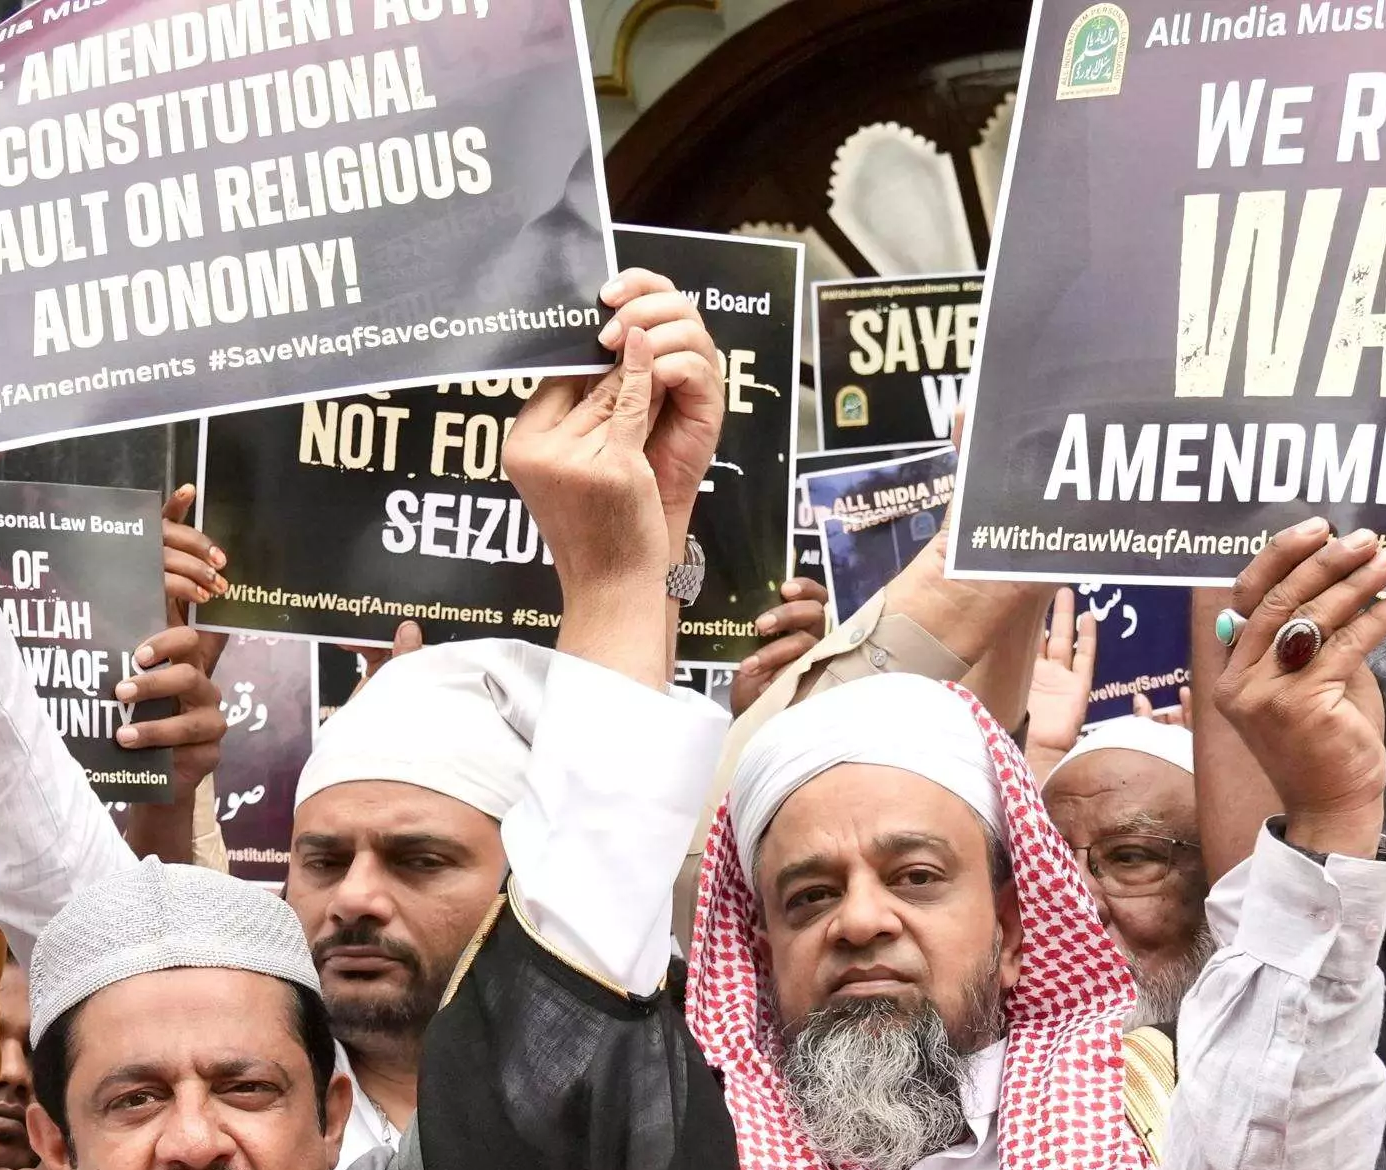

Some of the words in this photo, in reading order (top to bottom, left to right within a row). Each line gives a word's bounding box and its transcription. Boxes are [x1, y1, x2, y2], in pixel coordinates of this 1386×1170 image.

[17, 0, 354, 105] AMENDMENT
[1145, 13, 1191, 48] All
[1200, 7, 1287, 43] India
[1197, 79, 1313, 169] WE
[124, 173, 205, 248] ON
[214, 126, 493, 234] RELIGIOUS
[33, 236, 362, 357] AUTONOMY!
[706, 288, 771, 315] Board
[209, 304, 600, 371] #SaveWaqfSaveConstitution
[299, 400, 410, 473] NOT
[50, 513, 86, 532] Law
[90, 516, 144, 536] Board
[834, 494, 870, 514] ALL
[873, 482, 931, 508] INDIA
[382, 489, 554, 566] SEIZU
[971, 526, 1275, 559] #WithdrawWaqfAmend
[13, 550, 50, 590] OF
[221, 583, 504, 626] WithdrawWaqfAmendments
